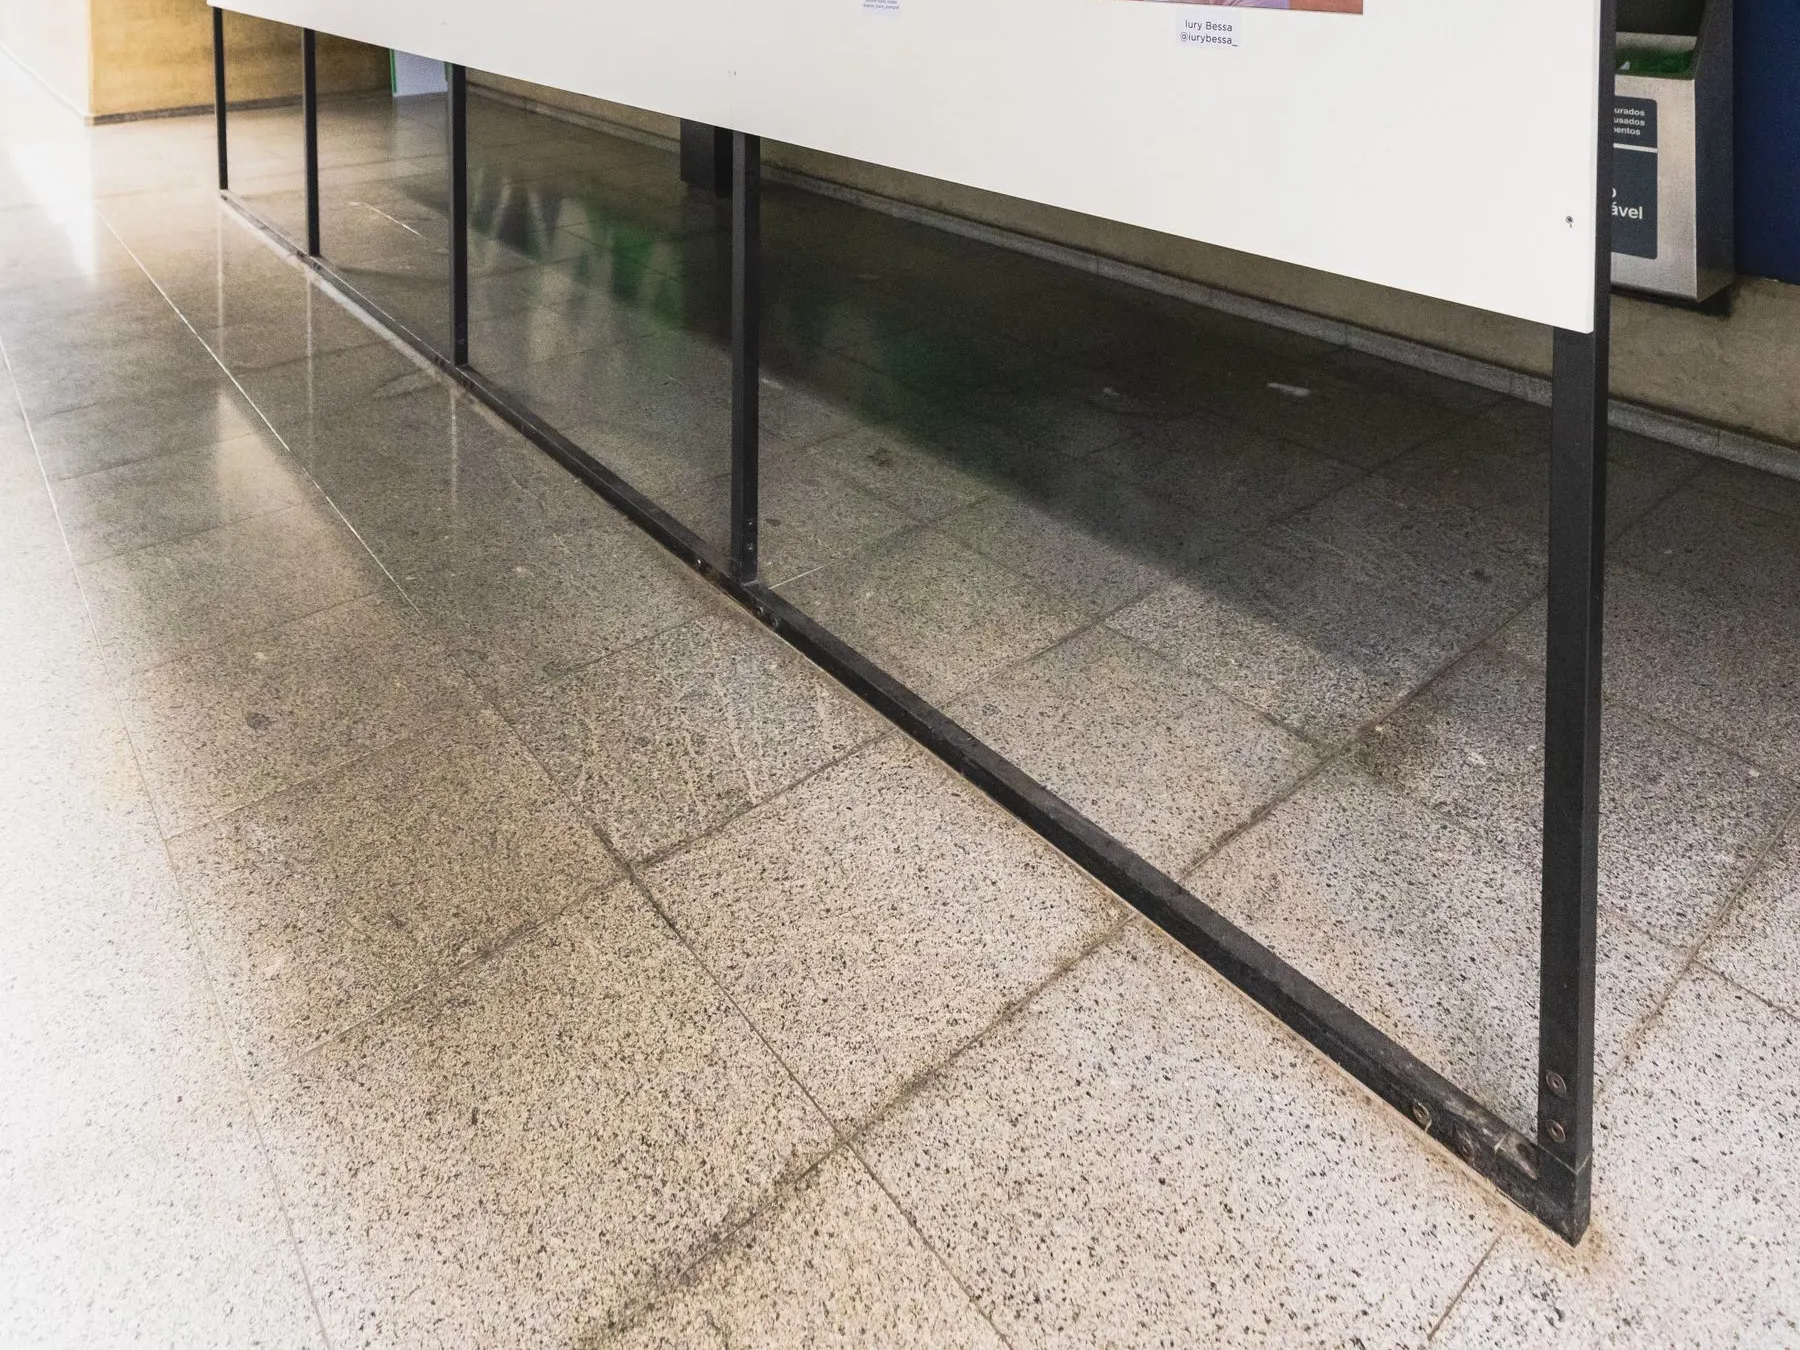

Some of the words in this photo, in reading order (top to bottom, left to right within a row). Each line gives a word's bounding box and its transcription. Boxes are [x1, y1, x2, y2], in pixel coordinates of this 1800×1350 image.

[1185, 19, 1203, 31] Iury
[1205, 21, 1233, 32] Bessa
[1180, 31, 1238, 47] @iurybessa_
[1613, 127, 1641, 136] entos
